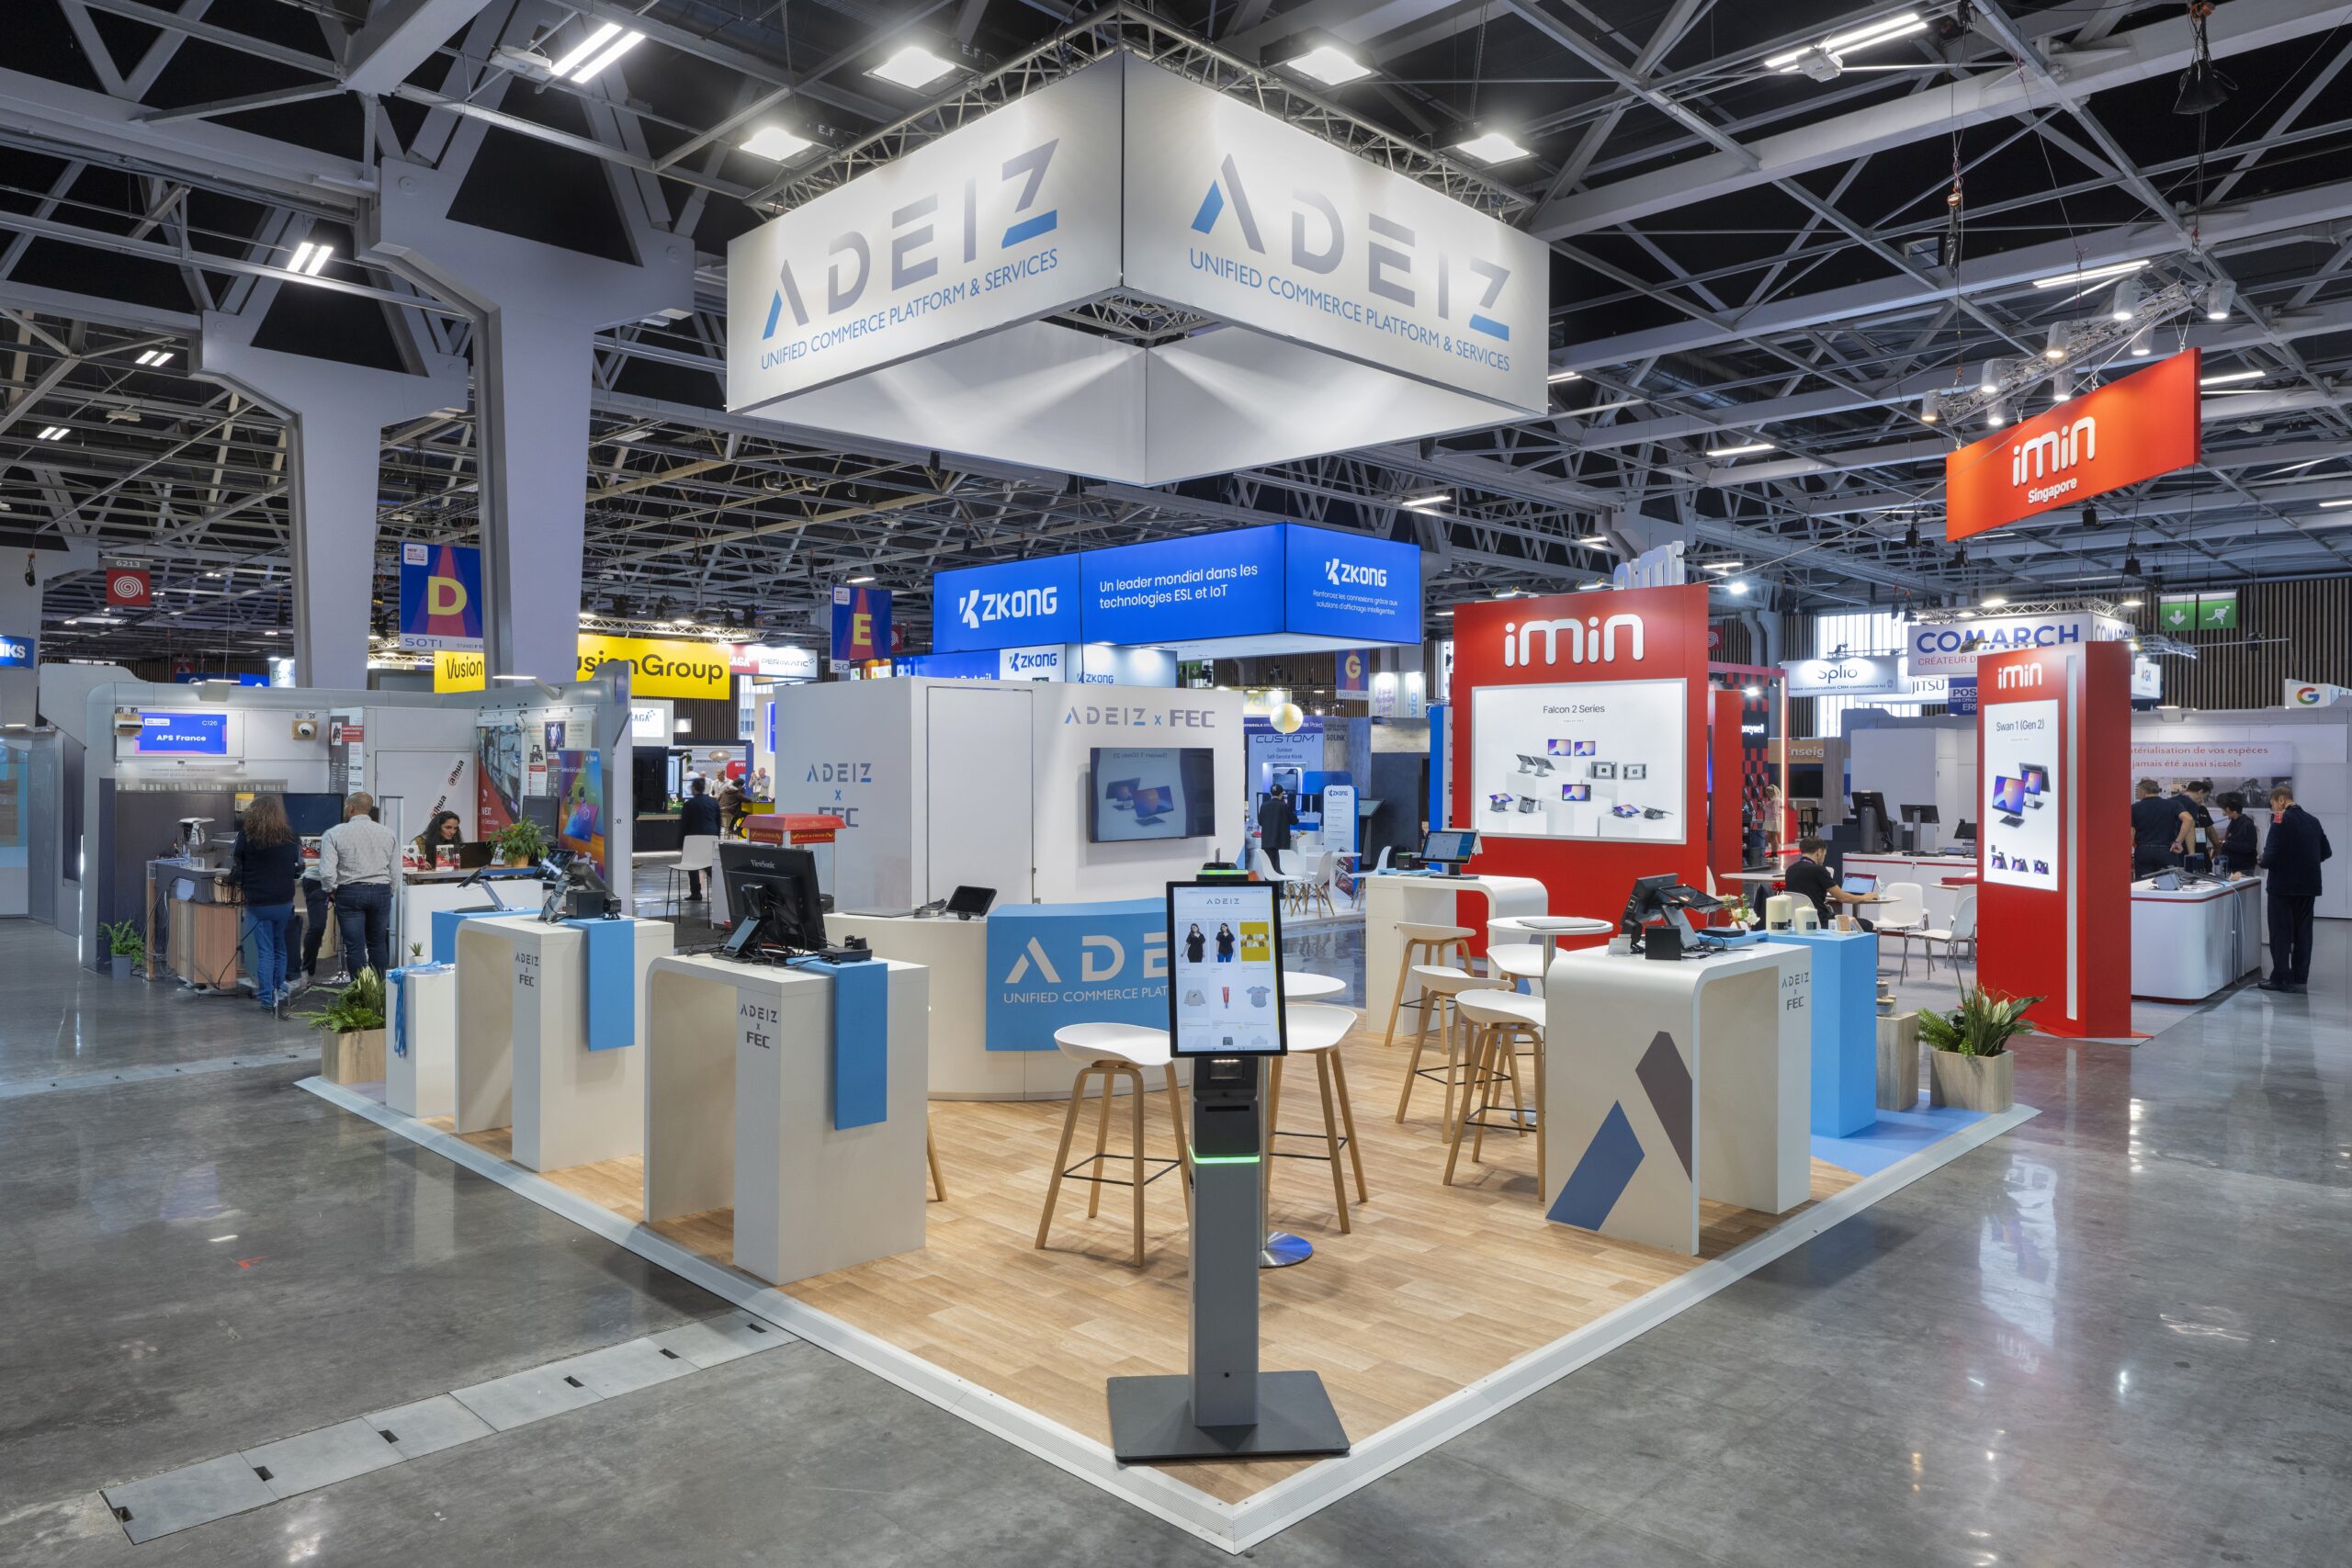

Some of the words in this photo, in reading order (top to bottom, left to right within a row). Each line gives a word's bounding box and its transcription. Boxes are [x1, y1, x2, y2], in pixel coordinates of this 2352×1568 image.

[762, 138, 1059, 341] ADEIZ
[1190, 152, 1511, 342] ADEIZ
[761, 341, 808, 370] UNIFIED
[810, 311, 886, 353] COMMERCE
[888, 282, 966, 326] PLATFORM
[969, 277, 980, 296] &
[984, 248, 1057, 292] SERVICES
[1190, 247, 1262, 288] UNIFIED
[1268, 275, 1362, 322] COMMERCE
[1366, 308, 1440, 348] PLATFORM
[1443, 336, 1453, 352] &
[1456, 340, 1510, 372] SERVICES
[2028, 478, 2077, 504] Singapore
[116, 559, 141, 568] 6213
[1099, 581, 1114, 593] Un
[1116, 576, 1152, 592] leader
[1154, 569, 1204, 586] mondial
[1205, 565, 1238, 581] dans
[1239, 563, 1258, 577] les
[1340, 563, 1387, 587] ZKONG
[427, 575, 468, 616] D
[982, 586, 1057, 622] ZKONG
[1100, 591, 1172, 609] technologies
[1174, 587, 1193, 602] ESL
[1195, 587, 1207, 599] et
[1209, 584, 1228, 598] IoT
[1313, 589, 1339, 599] Renforcez
[1346, 594, 1374, 604] connexions
[1316, 601, 1339, 609] solutions
[1367, 605, 1396, 616] intelligentes
[853, 613, 872, 646] E
[1917, 624, 2079, 654] COMARCH
[404, 637, 443, 649] SOTI
[446, 656, 483, 680] Vusion
[577, 649, 724, 685] sinGroup
[1020, 652, 1057, 669] ZKONG
[1344, 655, 1362, 680] G
[1917, 655, 1968, 666] CRÉATEUR
[1085, 673, 1114, 684] ZKONG
[1817, 664, 1858, 683] Splio
[1912, 679, 1945, 695] JITSU
[1952, 688, 1977, 697] POS
[1064, 705, 1147, 727] ADEIZ
[1169, 709, 1216, 728] FEC
[1543, 705, 1570, 714] Falcon
[1572, 705, 1577, 714] 2
[1578, 704, 1606, 714] Series
[1996, 721, 2014, 732] Swan
[2015, 721, 2018, 731] 1
[2020, 718, 2036, 732] (Gen
[2037, 717, 2045, 731] 2)
[156, 734, 174, 742] APS
[175, 734, 207, 742] France
[1256, 734, 1315, 743] CUSTOM
[2193, 746, 2206, 754] de
[2227, 746, 2268, 756] espèces
[807, 762, 872, 783] ADEIZ
[2132, 759, 2163, 769] jamais
[2165, 759, 2179, 767] été
[2182, 759, 2207, 767] aussi
[750, 859, 775, 869] ViewSonic
[515, 952, 539, 967] ADEIZ
[1004, 931, 1168, 984] ADE
[519, 974, 535, 987] FEC
[1781, 971, 1809, 989] ADEIZ
[1003, 992, 1058, 1004] UNIFIED
[1062, 987, 1138, 1003] COMMERCE
[1141, 985, 1168, 998] PLAT
[1786, 996, 1805, 1011] FEC
[740, 1003, 777, 1024] ADEIZ
[746, 1031, 771, 1050] FEC
